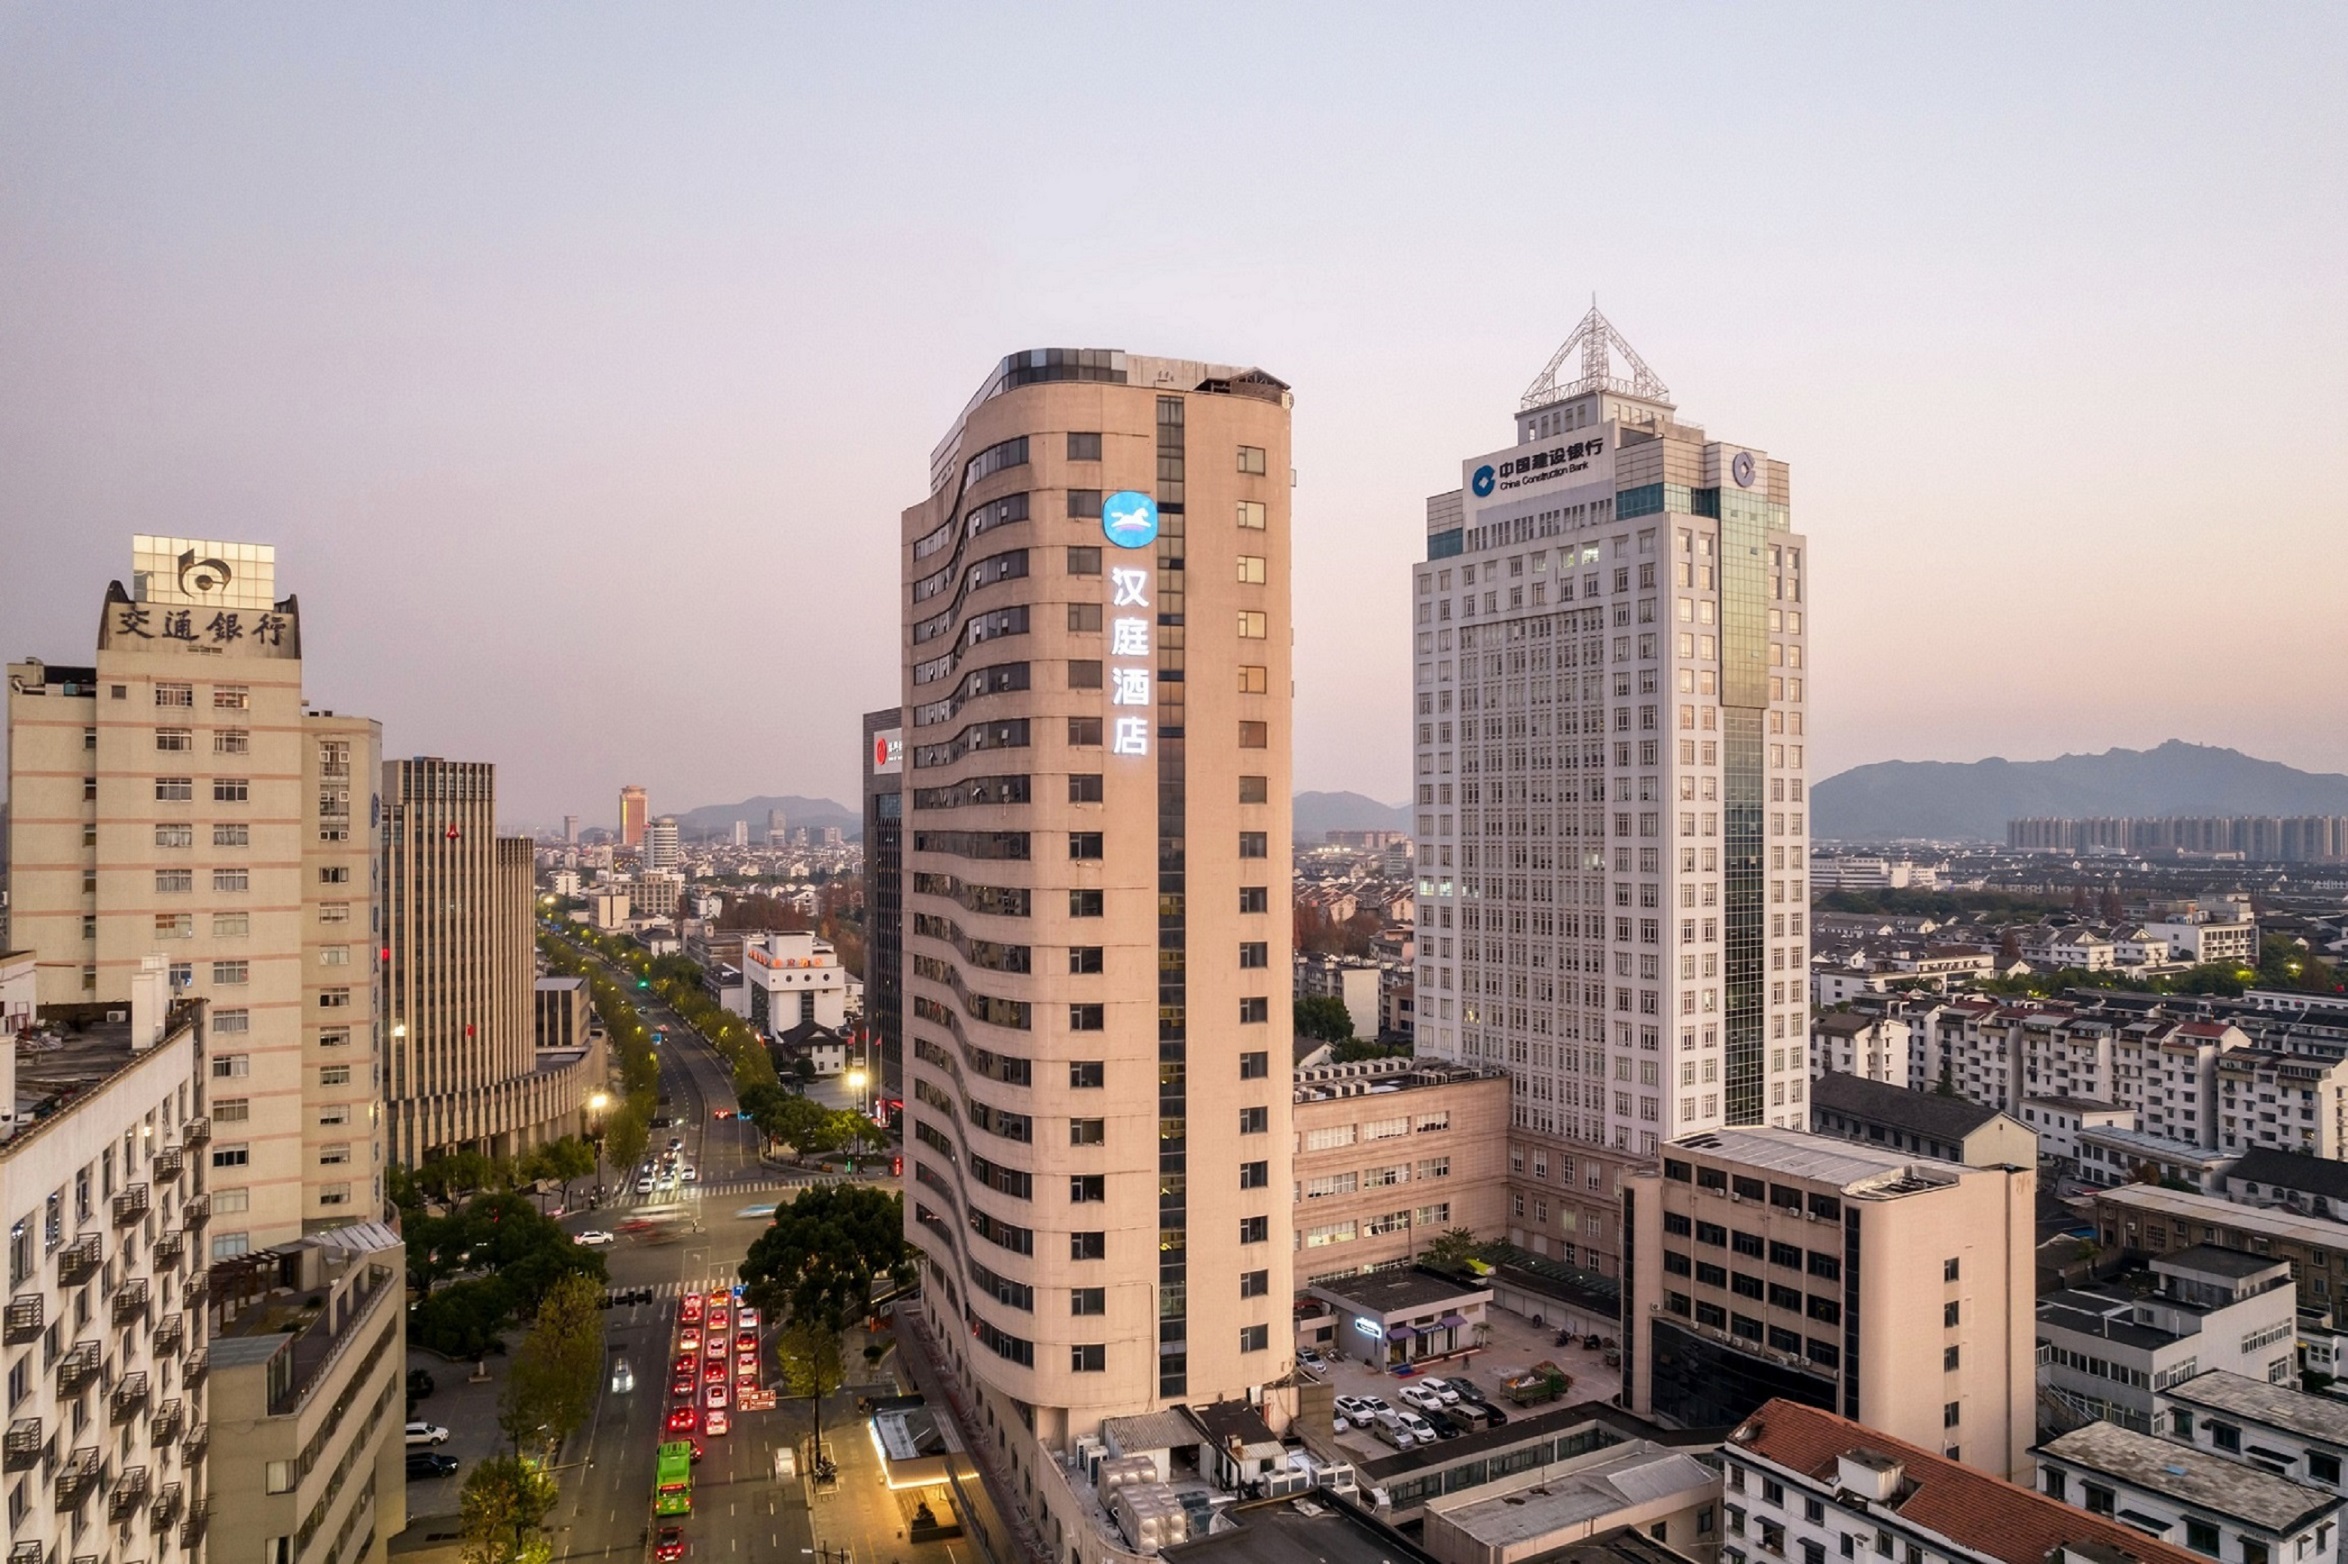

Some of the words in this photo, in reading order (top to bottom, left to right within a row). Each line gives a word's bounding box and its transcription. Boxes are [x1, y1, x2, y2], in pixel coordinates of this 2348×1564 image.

[1499, 437, 1604, 479] 中国建设银行
[1499, 480, 1521, 491] China
[1522, 467, 1568, 485] Construction
[1569, 461, 1589, 473] Bank
[116, 605, 287, 647] 交通銀行
[1111, 567, 1150, 757] 汉庭酒店
